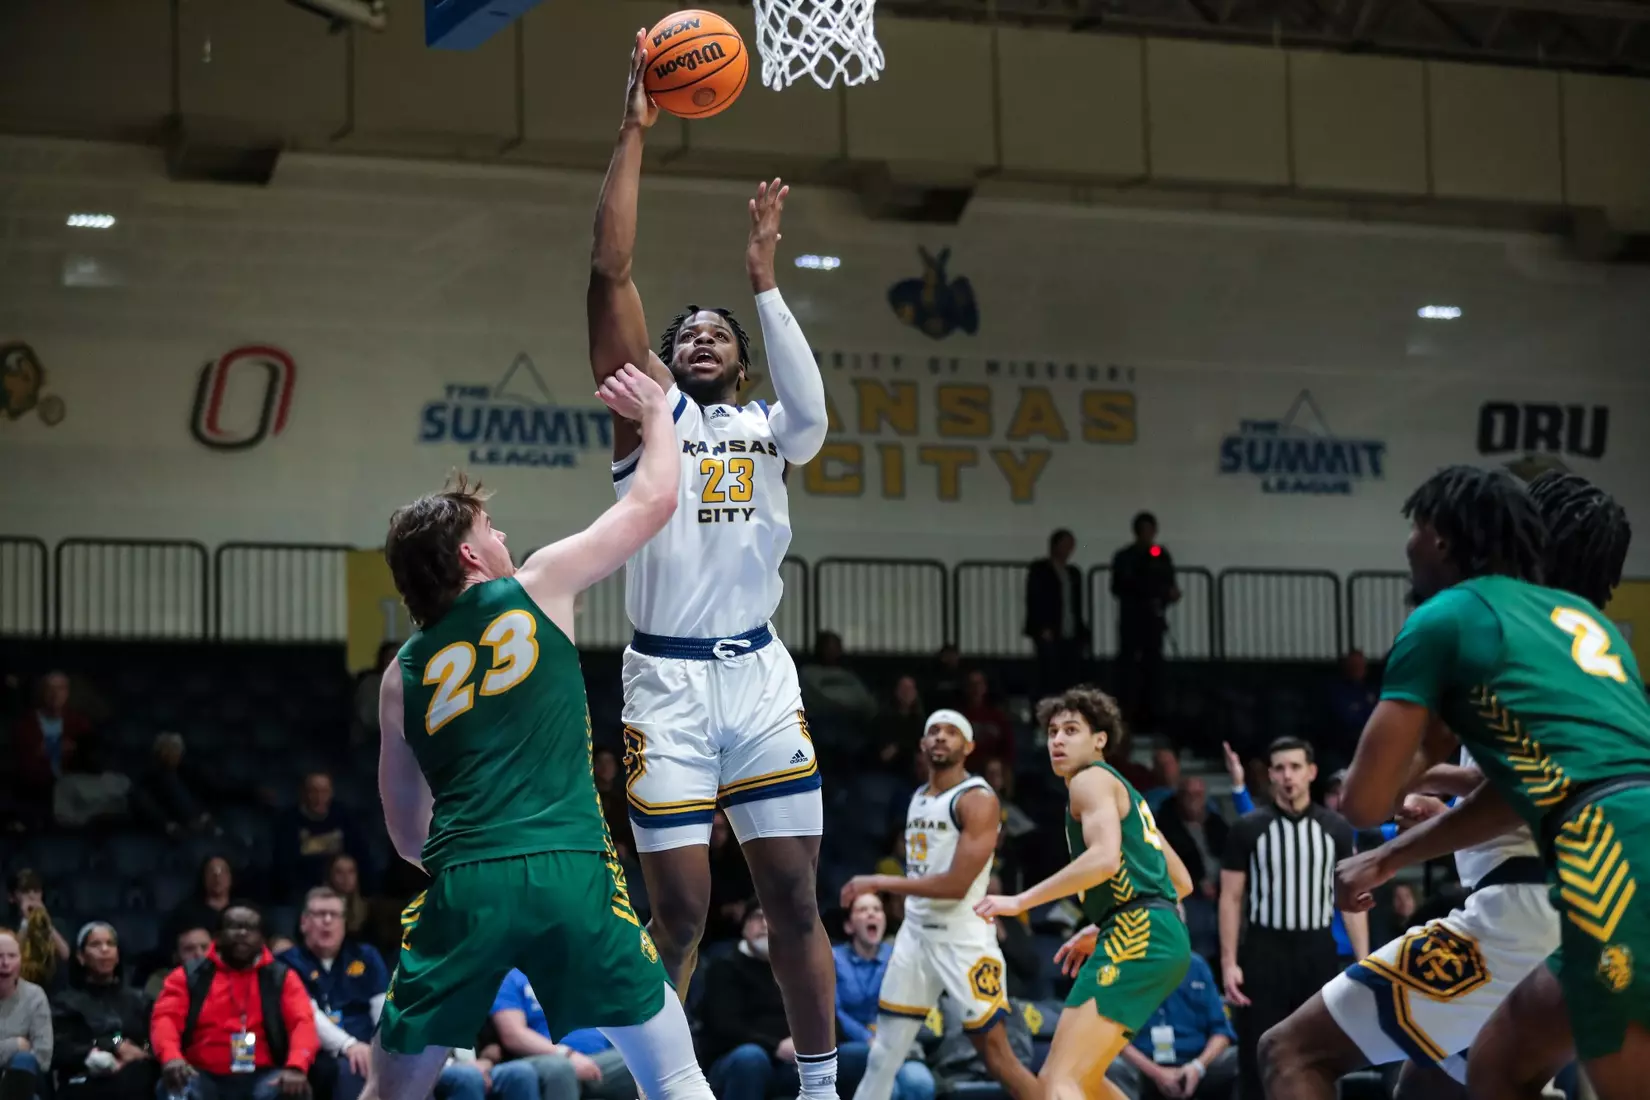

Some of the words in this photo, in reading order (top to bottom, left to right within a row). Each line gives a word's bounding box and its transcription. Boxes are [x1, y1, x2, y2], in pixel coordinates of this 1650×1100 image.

[652, 18, 701, 48] NCAA
[653, 41, 726, 79] Wilson
[446, 383, 490, 399] THE
[738, 374, 1138, 445] NSAS
[418, 401, 614, 449] SUMMIT
[1478, 402, 1610, 460] ORU
[469, 450, 577, 467] LEAGUE
[682, 440, 778, 457] KANSAS
[1218, 435, 1387, 479] SUMMIT
[700, 458, 754, 503] 23
[803, 443, 1053, 504] CITY
[1261, 480, 1352, 494] LEAGUE
[697, 508, 756, 523] CITY
[1550, 605, 1628, 684] 2
[422, 609, 539, 736] 23
